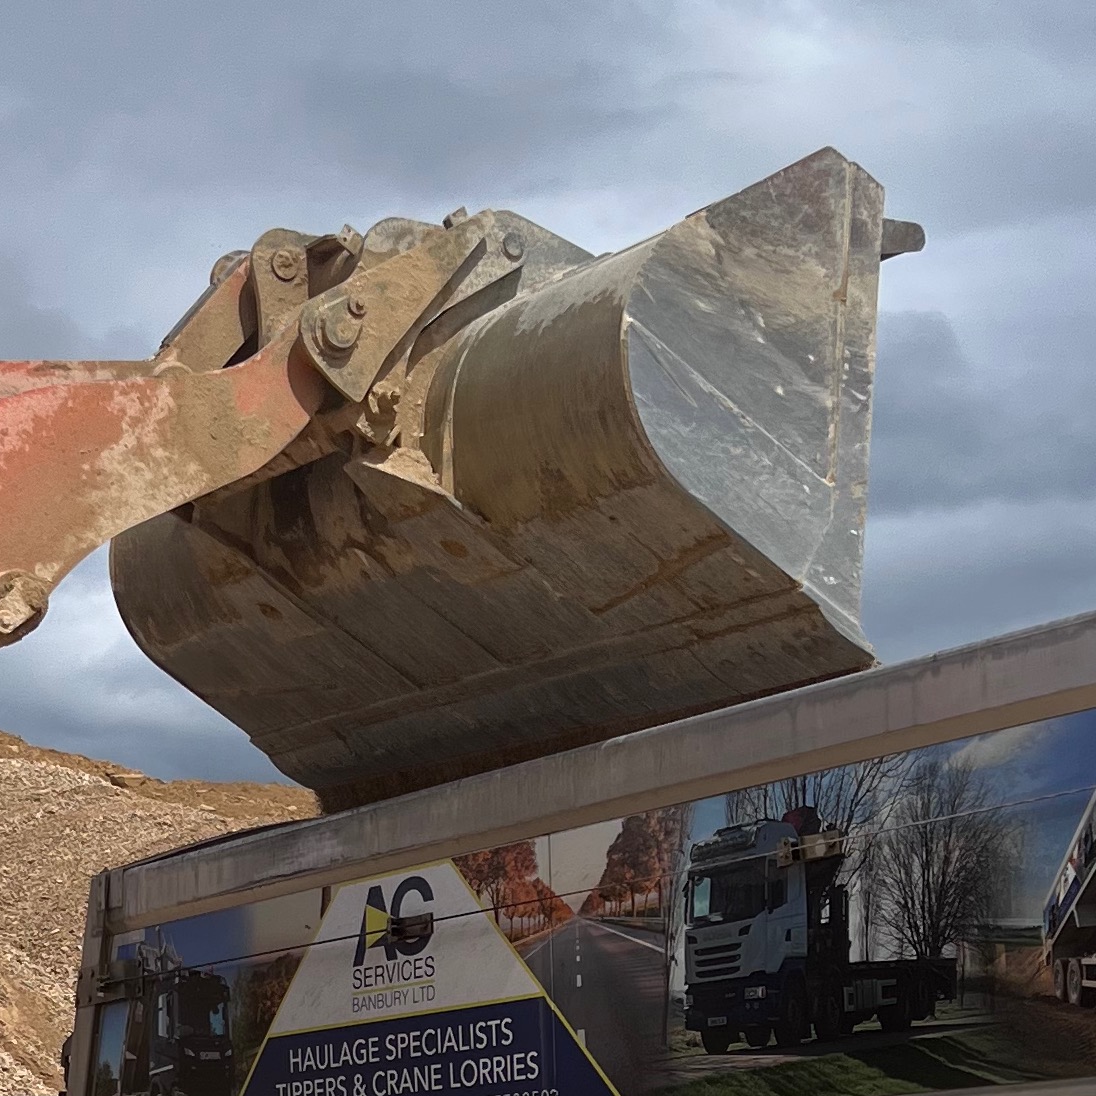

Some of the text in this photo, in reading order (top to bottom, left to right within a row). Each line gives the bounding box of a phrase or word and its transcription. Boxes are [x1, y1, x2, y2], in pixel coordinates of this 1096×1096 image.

[352, 955, 435, 990] SERVICES
[352, 985, 436, 1013] BANBURY LTD
[289, 1017, 514, 1074] HAULAGE SPECIALISTS
[372, 1063, 444, 1096] CRANE
[449, 1051, 540, 1089] LORRIES
